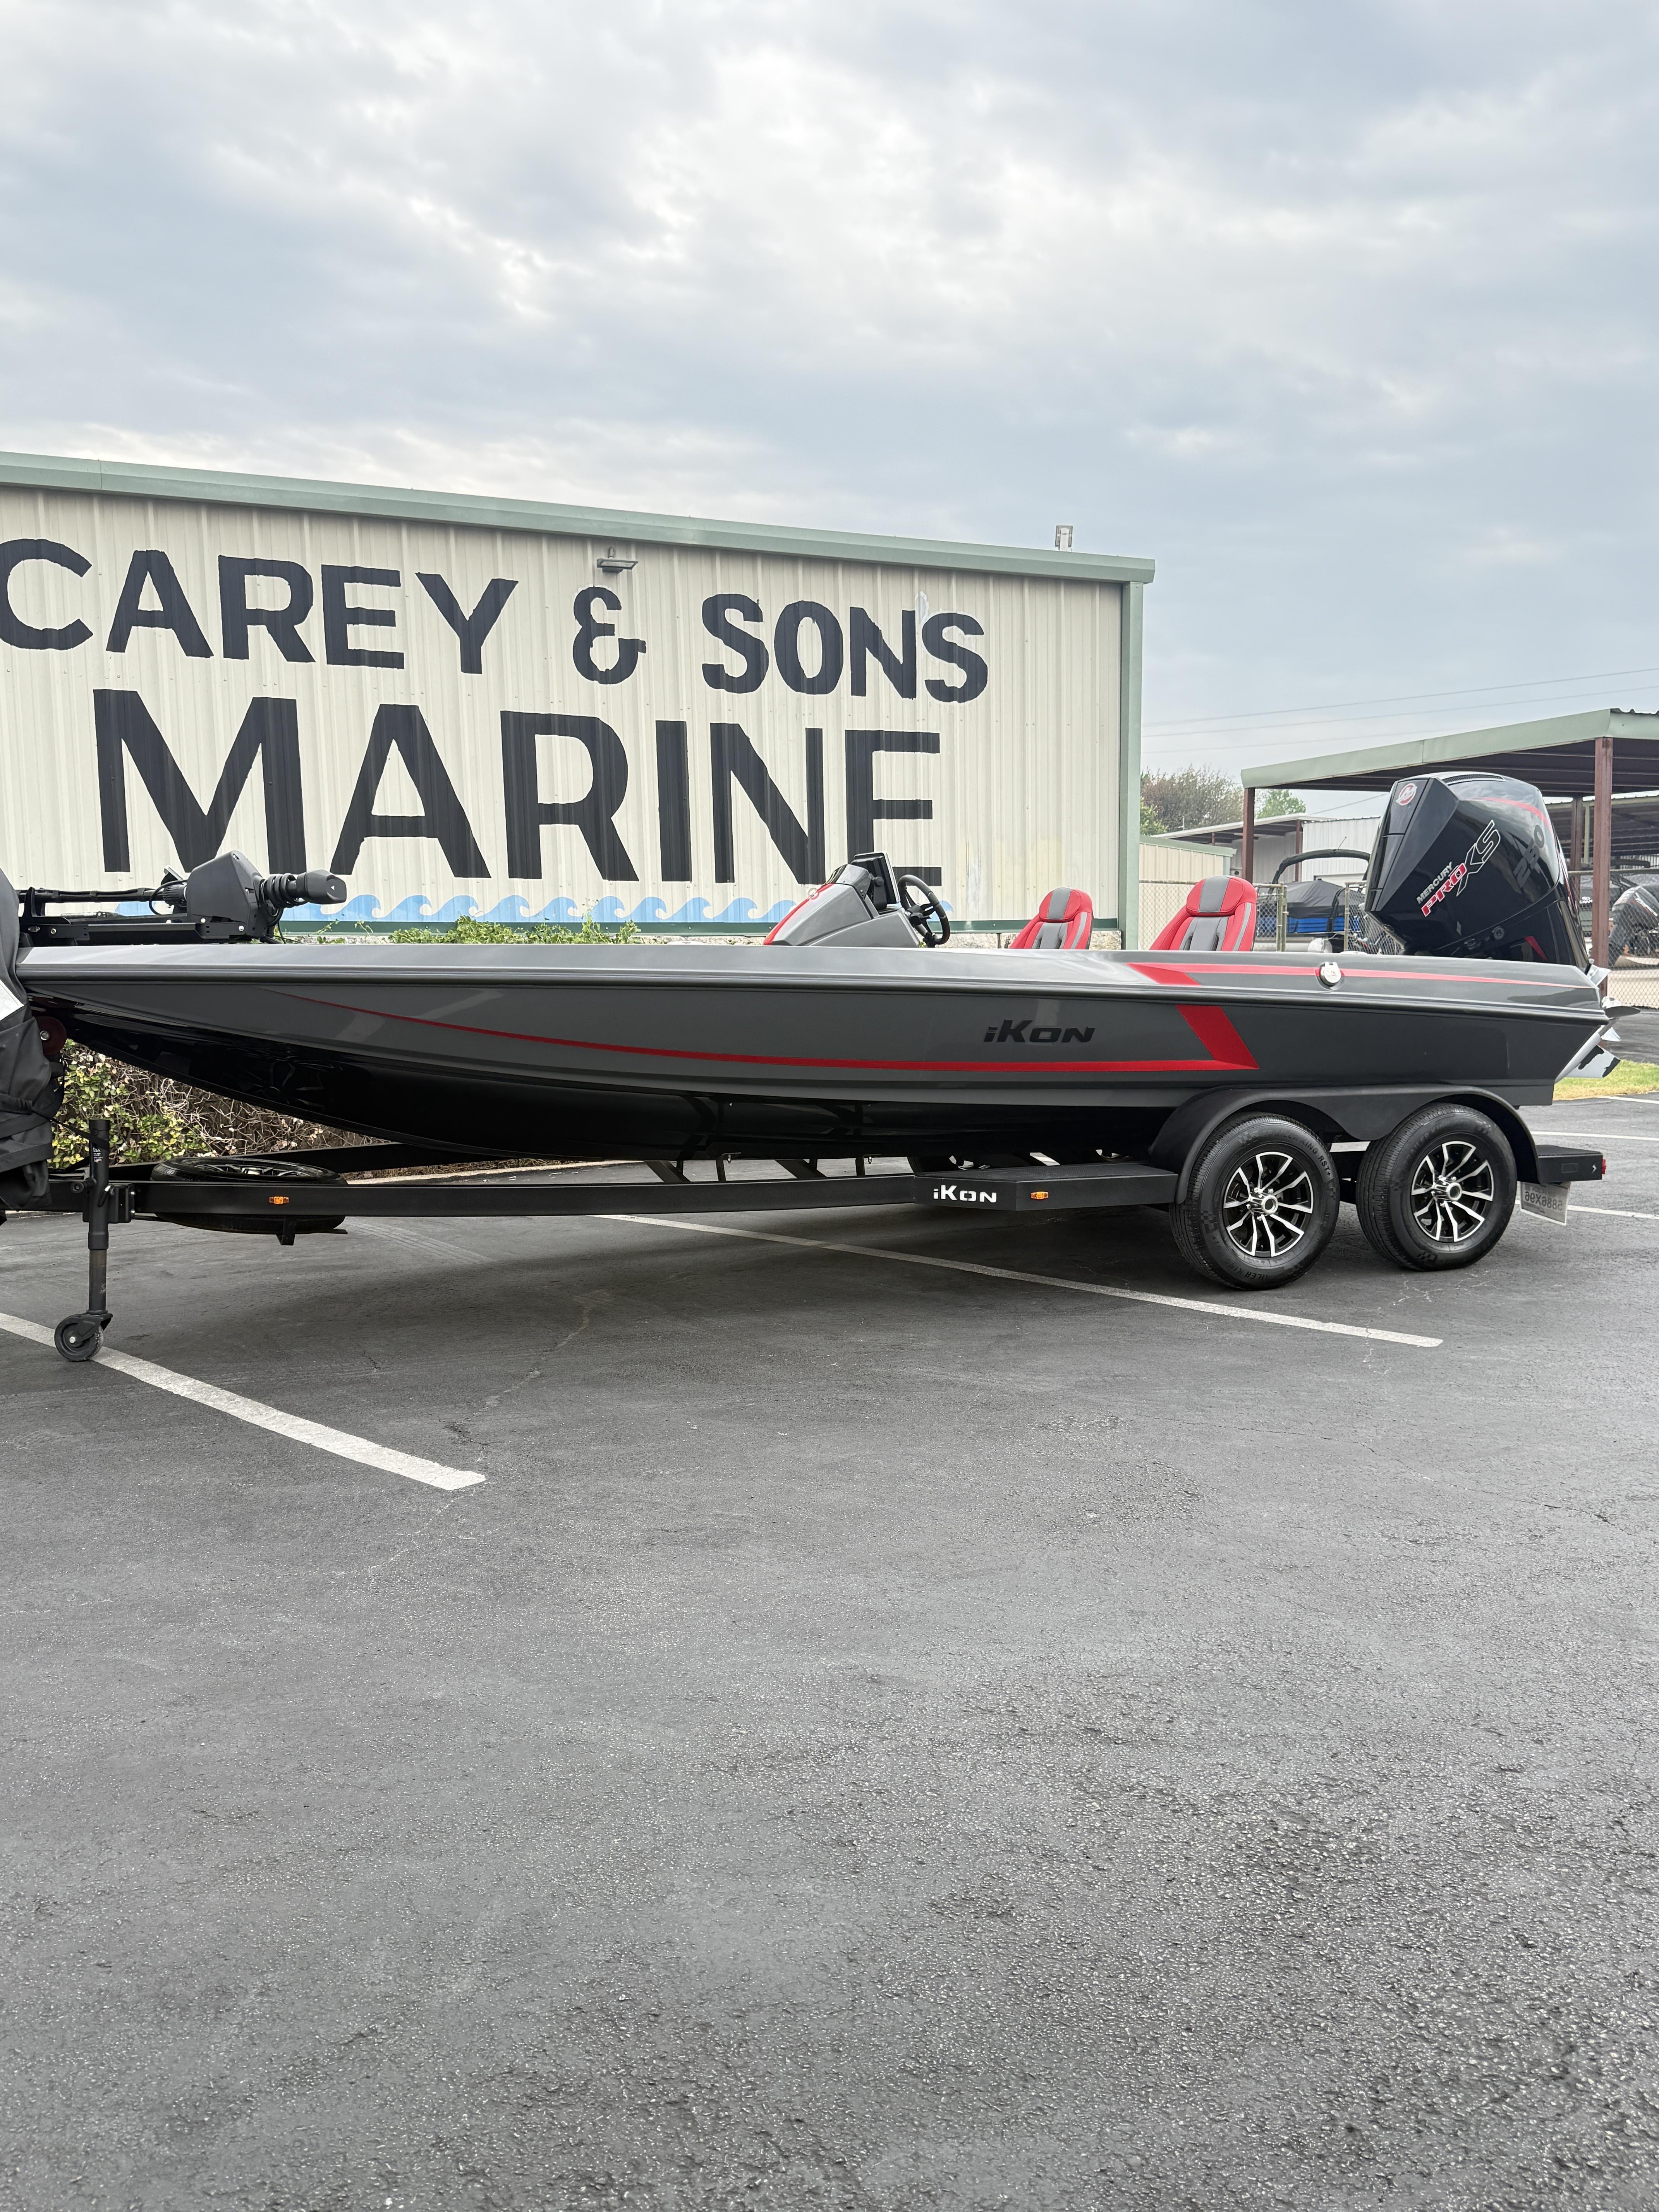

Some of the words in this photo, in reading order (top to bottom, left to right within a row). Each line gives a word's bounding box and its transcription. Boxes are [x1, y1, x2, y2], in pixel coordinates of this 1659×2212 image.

[0, 538, 519, 675] CAREY
[573, 586, 647, 685] &
[702, 593, 988, 704] SONS
[93, 689, 942, 886] MARINE
[1416, 861, 1452, 904] MERCURY
[1513, 824, 1545, 888] 250
[1421, 863, 1467, 917] PRO
